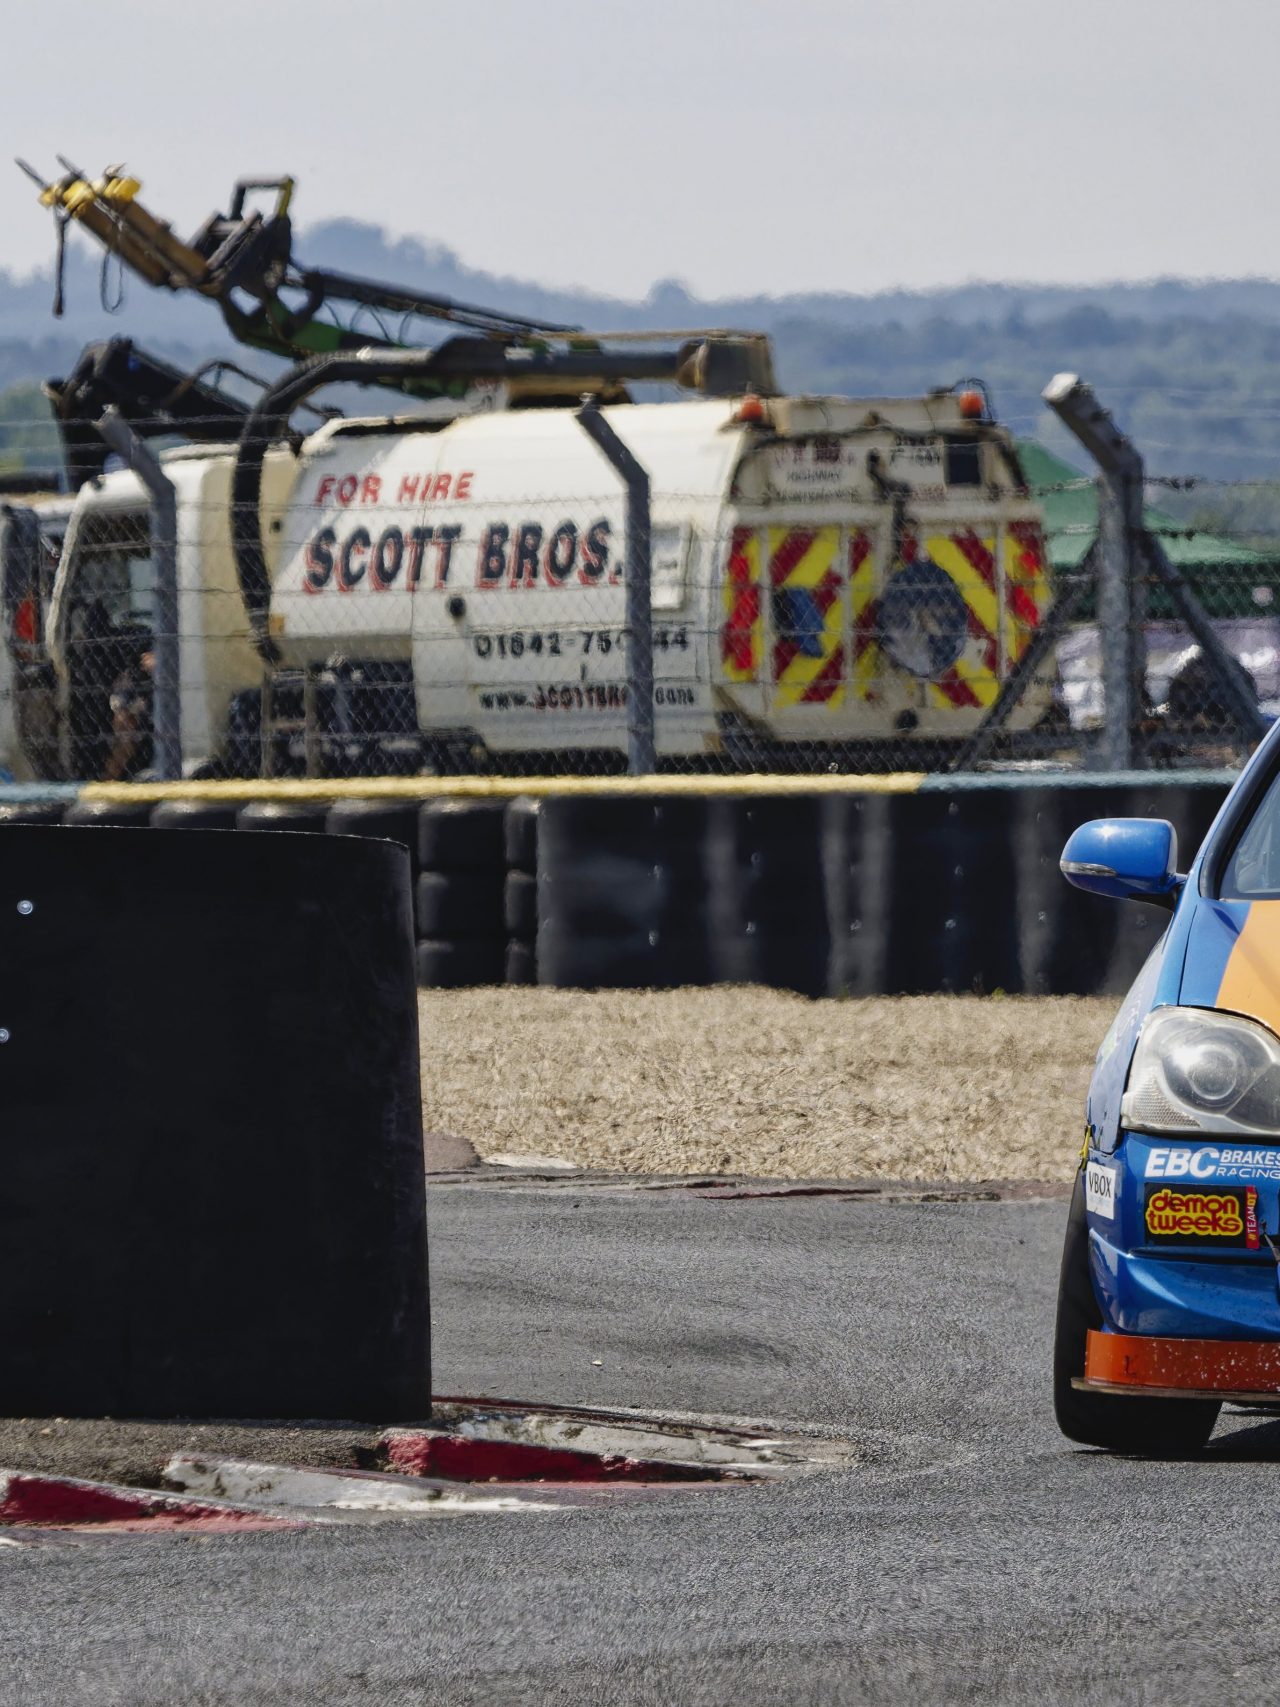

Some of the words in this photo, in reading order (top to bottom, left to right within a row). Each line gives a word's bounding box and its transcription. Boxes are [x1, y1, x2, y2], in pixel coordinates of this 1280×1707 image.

[314, 473, 381, 506] FOR
[397, 472, 474, 503] HIRE
[303, 524, 462, 593] SCOTT
[475, 518, 623, 588] BROS.
[1144, 1147, 1219, 1178] EBC
[1088, 1171, 1112, 1198] VBOX
[1150, 1190, 1238, 1214] demon
[1147, 1210, 1242, 1234] tweeks
